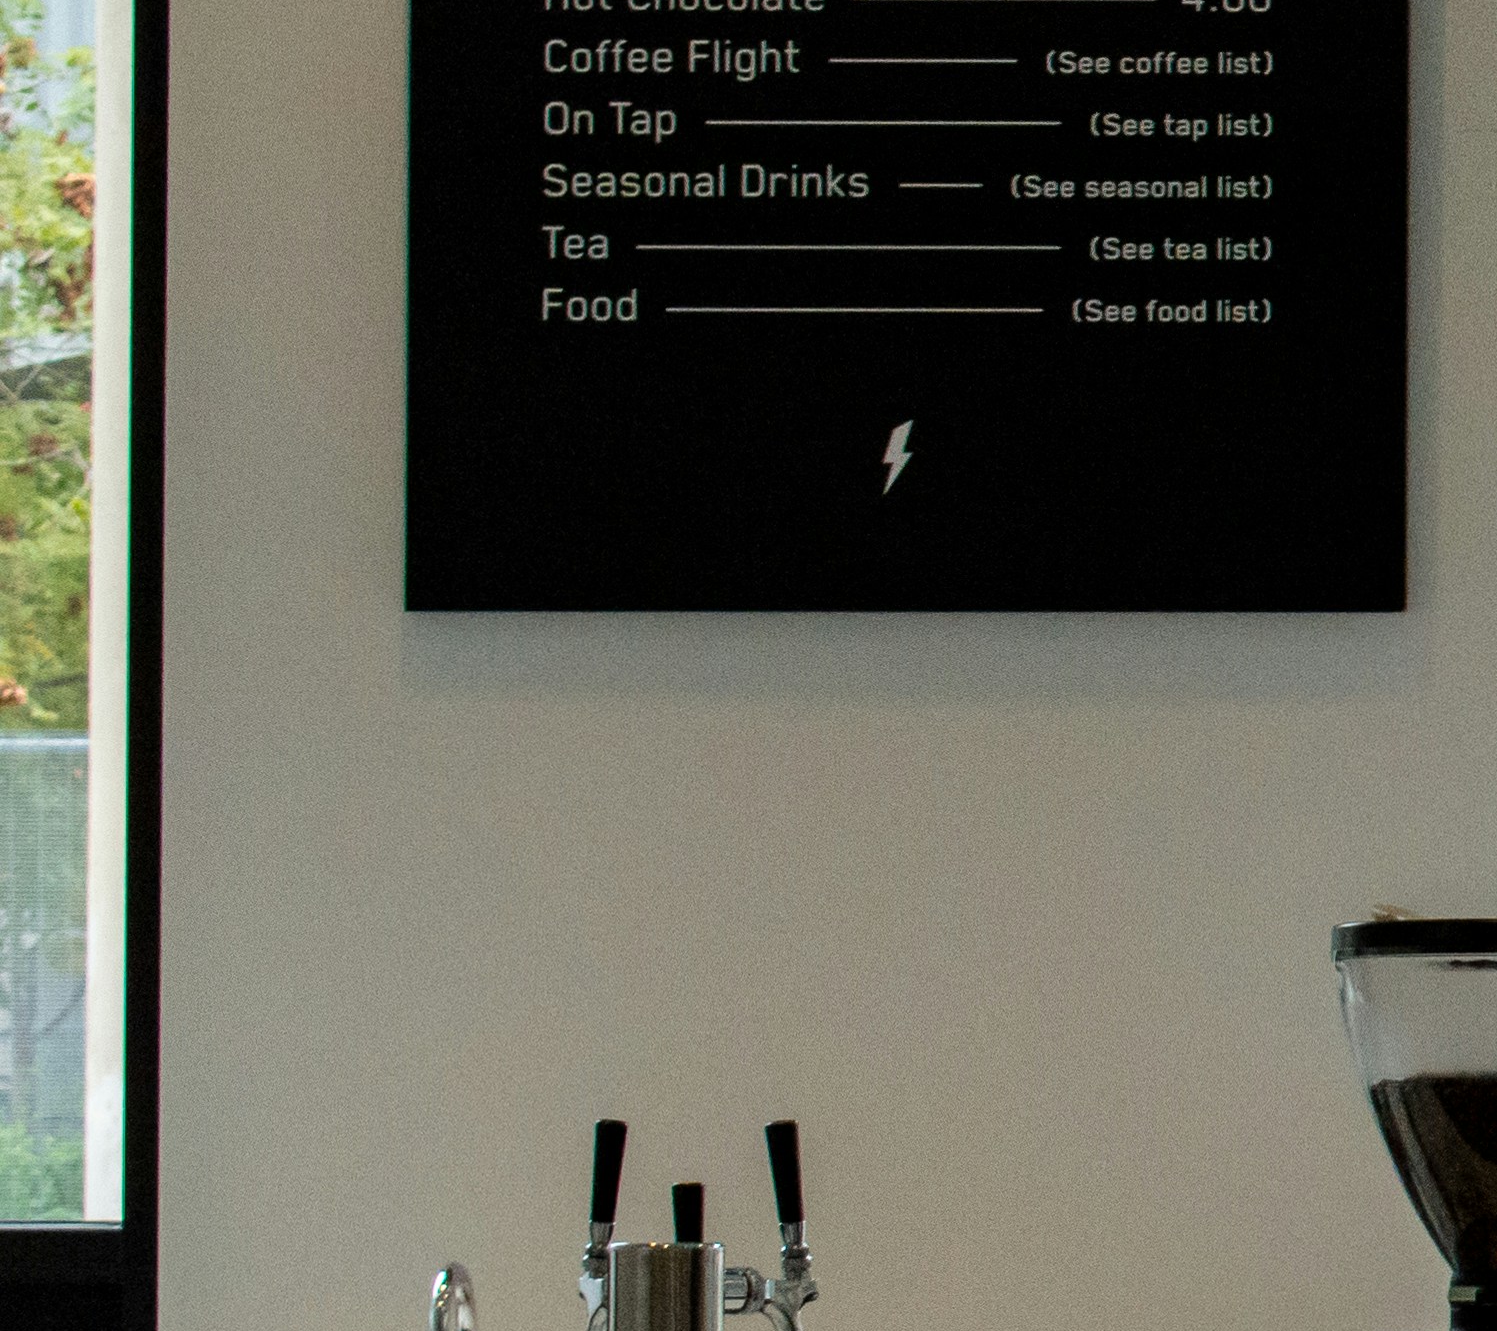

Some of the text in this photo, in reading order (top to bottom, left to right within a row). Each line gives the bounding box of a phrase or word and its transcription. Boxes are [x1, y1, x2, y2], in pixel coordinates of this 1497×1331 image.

[543, 38, 1274, 83] Coffee Flight (See coffee list)
[543, 100, 1273, 144] On Tap (See tap list)
[542, 162, 1273, 200] Seasonal Drinks (See seasonal list)
[541, 224, 1273, 262] Tea (See tea list)
[541, 286, 1272, 324] Food (See food list)
